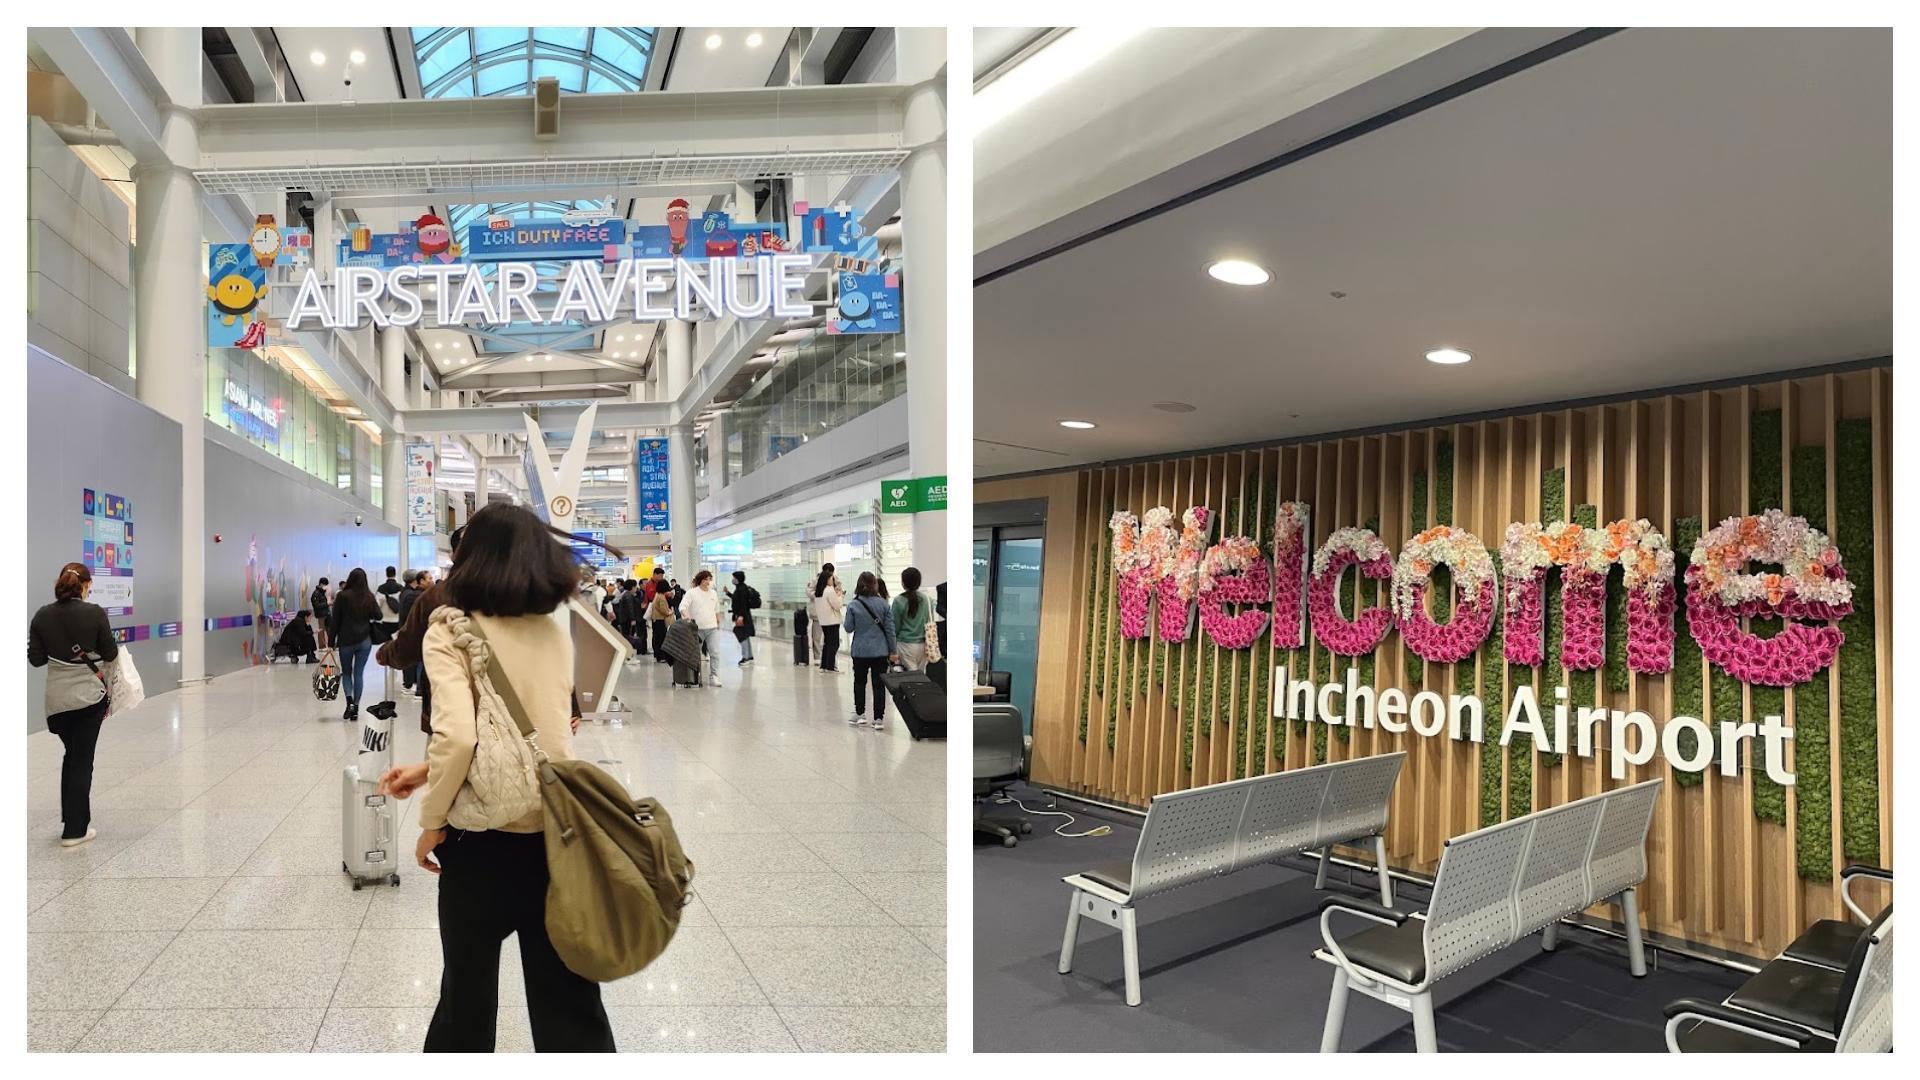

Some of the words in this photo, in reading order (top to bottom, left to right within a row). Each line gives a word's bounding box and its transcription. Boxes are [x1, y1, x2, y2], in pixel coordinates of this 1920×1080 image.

[482, 231, 515, 245] ICN
[286, 262, 543, 329] AIRSTAR
[550, 254, 814, 323] AVENUE
[1109, 501, 1855, 687] Welcome
[1273, 665, 1484, 743] Incheon
[1499, 685, 1797, 785] Airport
